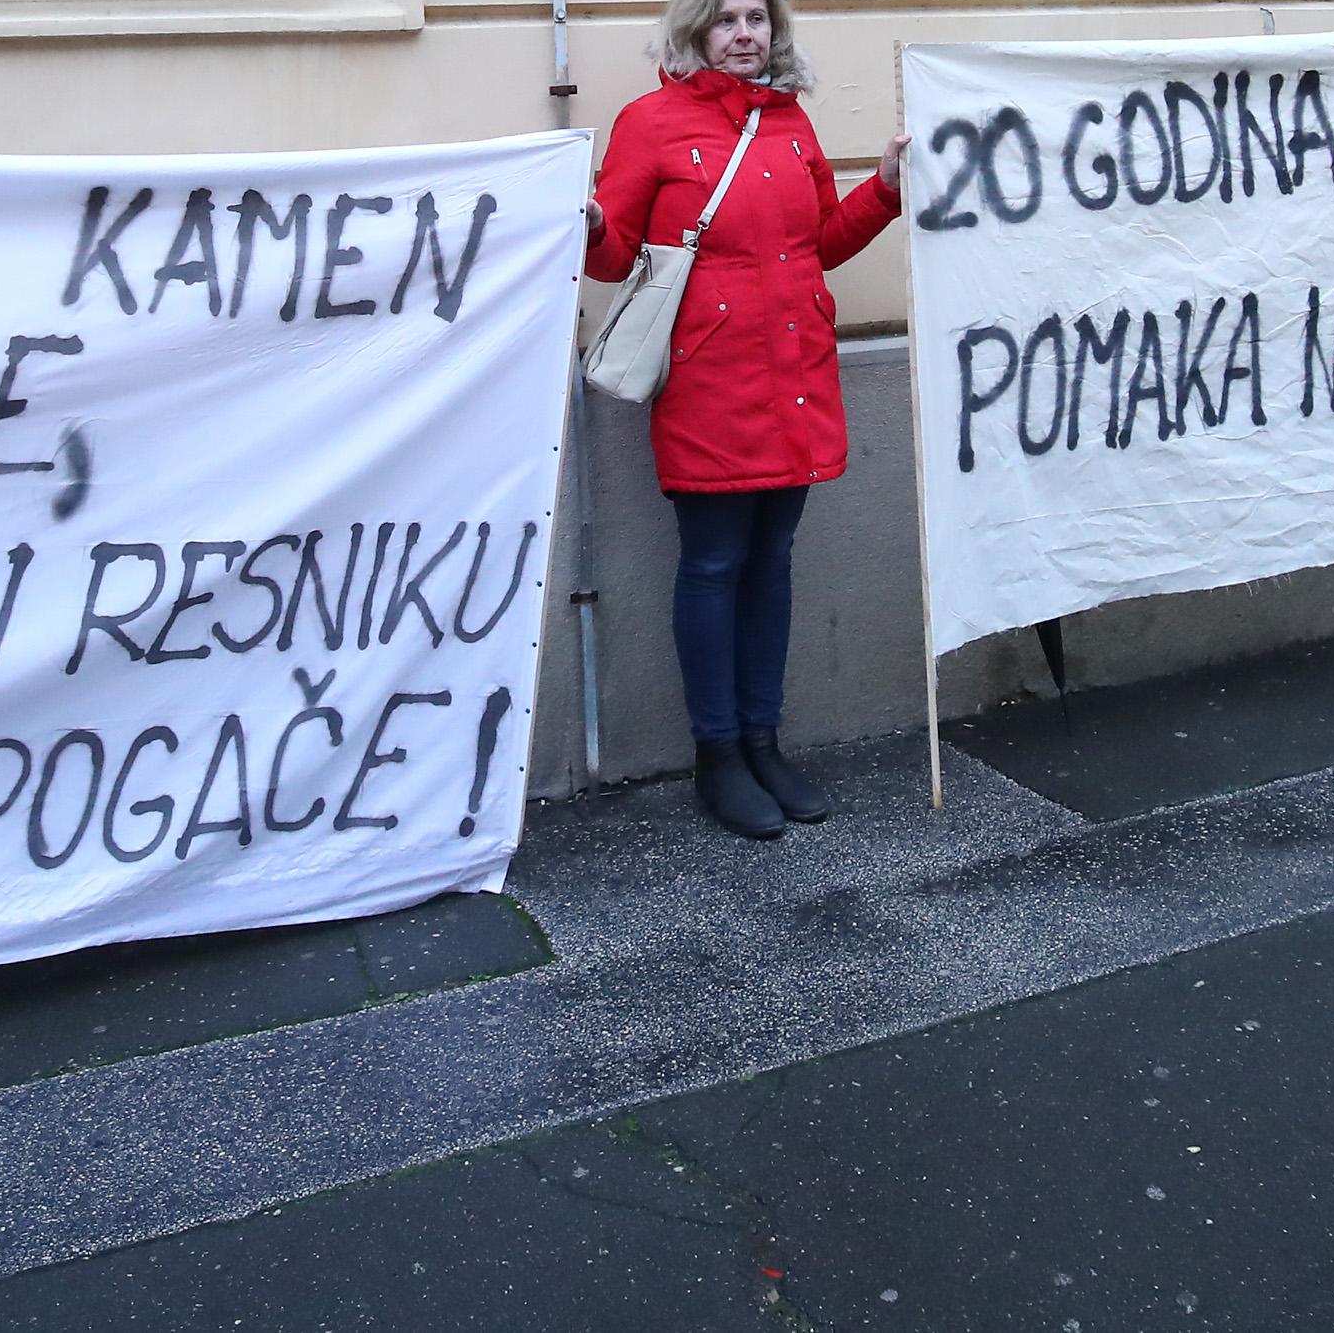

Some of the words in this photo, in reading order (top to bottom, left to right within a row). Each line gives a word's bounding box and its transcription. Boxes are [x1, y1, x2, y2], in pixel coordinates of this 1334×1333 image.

[916, 106, 1043, 231] 20
[63, 184, 498, 323] KAMEN
[957, 292, 1268, 473] POMAKA
[65, 521, 538, 676] RESNIKU
